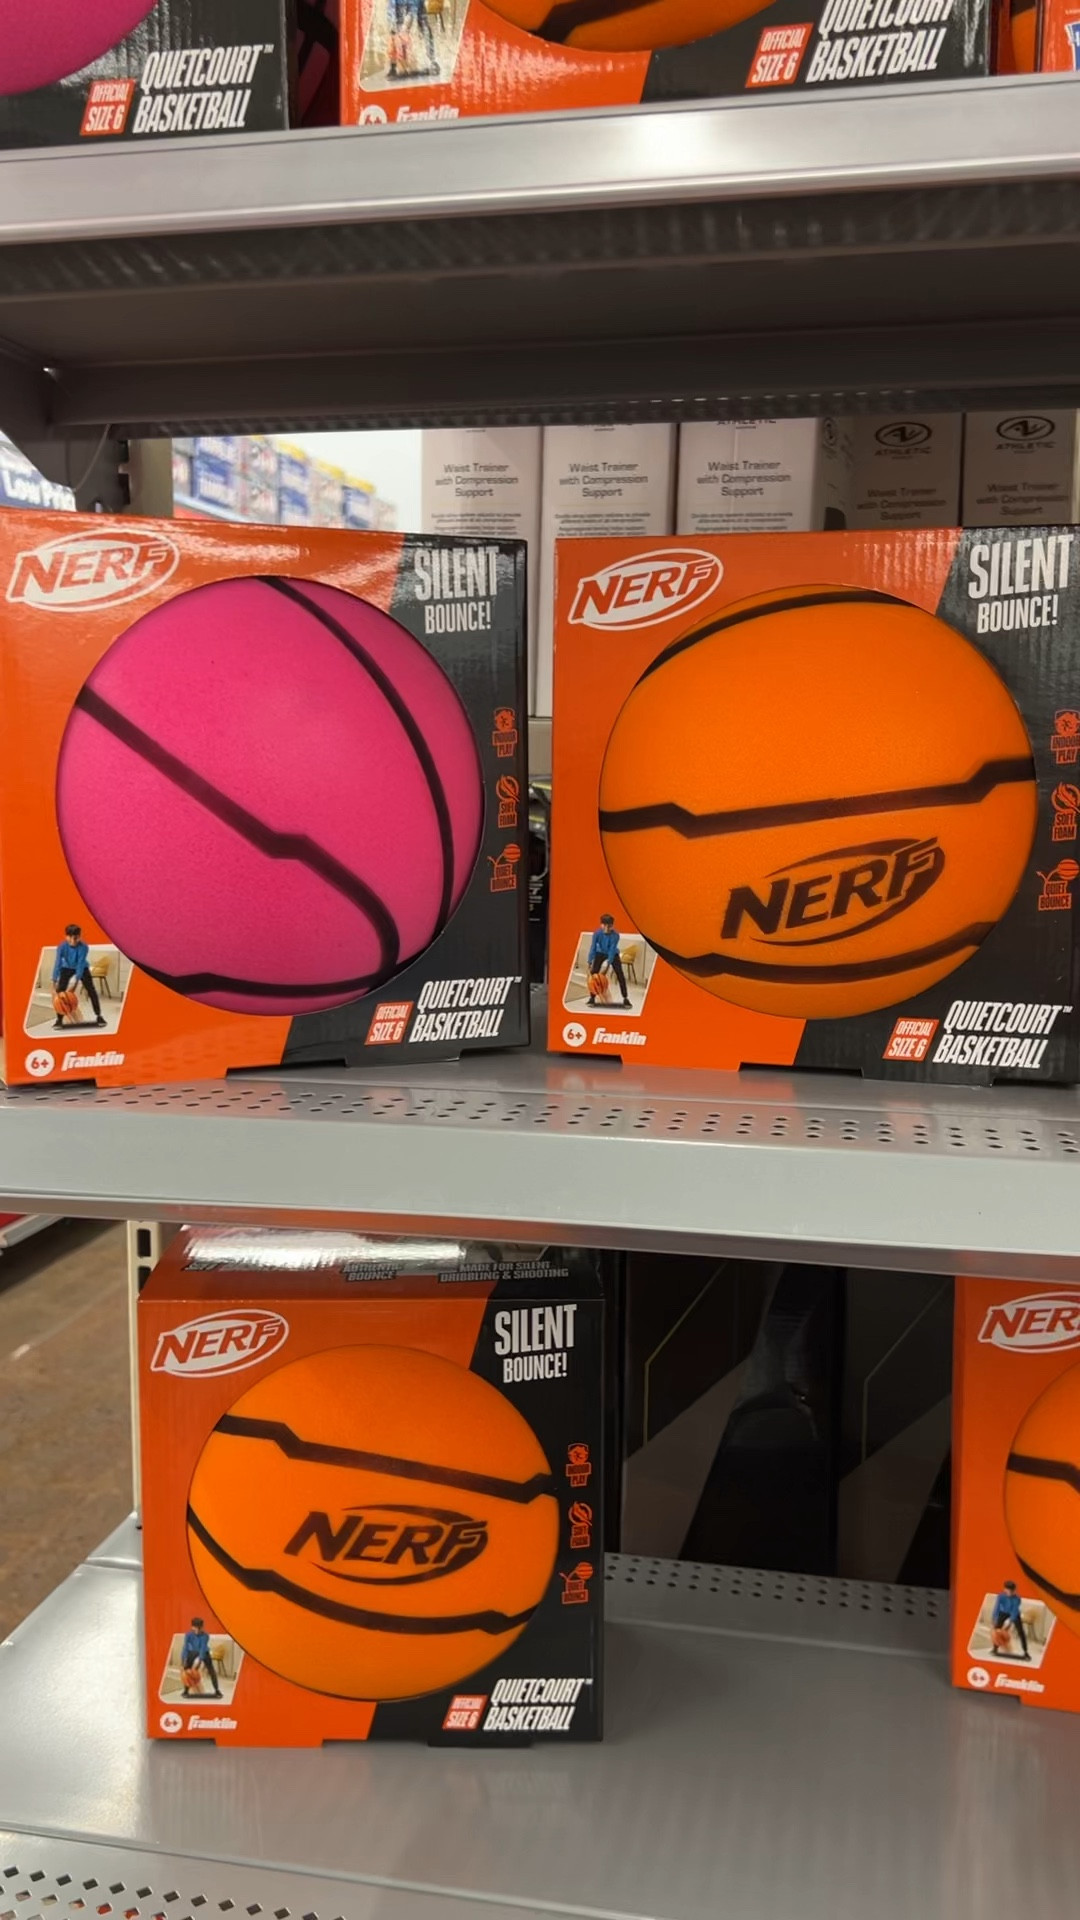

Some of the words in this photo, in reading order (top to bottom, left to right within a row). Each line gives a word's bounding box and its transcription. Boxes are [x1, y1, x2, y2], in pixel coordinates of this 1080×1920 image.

[761, 28, 807, 52] OFFICIAL
[805, 27, 947, 83] BASKETBALL
[751, 54, 785, 83] SIZE
[783, 52, 799, 80] 6
[91, 83, 130, 103] OFFICIAL
[85, 106, 113, 132] SIZE
[113, 105, 126, 130] 6
[132, 89, 252, 134] BASKETBALL
[443, 464, 471, 473] Waist
[472, 462, 510, 472] Trainer
[569, 463, 600, 473] Waist
[601, 461, 640, 472] Trainer
[707, 461, 740, 471] Waist
[742, 460, 781, 470] Trainer
[455, 475, 519, 486] Compression
[582, 475, 649, 486] Compression
[721, 473, 792, 485] Compression
[455, 487, 494, 498] Support
[582, 487, 623, 499] Support
[721, 486, 764, 498] Support
[8, 542, 170, 600] NERF
[414, 545, 499, 600] SILENT
[968, 534, 1074, 599] SILENT
[569, 558, 716, 624] NERF
[424, 601, 491, 634] BOUNCE!
[976, 594, 1058, 634] BOUNCE!
[1057, 749, 1077, 762] PLAY
[1055, 812, 1074, 826] SOFT
[1054, 826, 1076, 840] FOAM
[720, 836, 942, 940] NERF
[1045, 881, 1067, 895] QUIET
[1039, 895, 1071, 909] BOUNCE
[376, 1004, 409, 1020] OFFICIAL
[369, 1022, 395, 1042] SIZE
[394, 1021, 403, 1041] 6
[408, 1009, 504, 1043] BASKETBALL
[567, 1028, 582, 1040] 6+
[592, 1027, 647, 1046] Franklin
[896, 1021, 933, 1036] OFFICIAL
[888, 1037, 916, 1057] SIZE
[916, 1039, 927, 1058] 6
[932, 1033, 1049, 1069] BASKETBALL
[30, 1055, 50, 1070] 6+
[61, 1051, 125, 1072] Franklin
[439, 1271, 500, 1283] DRIBBLING
[502, 1270, 512, 1280] &
[513, 1268, 569, 1280] SHOOTING
[459, 1264, 490, 1273] MADE
[515, 1261, 551, 1271] SILENT
[494, 1303, 578, 1355] SILENT
[151, 1319, 282, 1371] NERF
[503, 1352, 568, 1384] BOUNCE!
[283, 1510, 488, 1566] NERF
[447, 1711, 470, 1728] SIZE
[467, 1711, 479, 1728] 6
[483, 1706, 576, 1731] BASKETBALL
